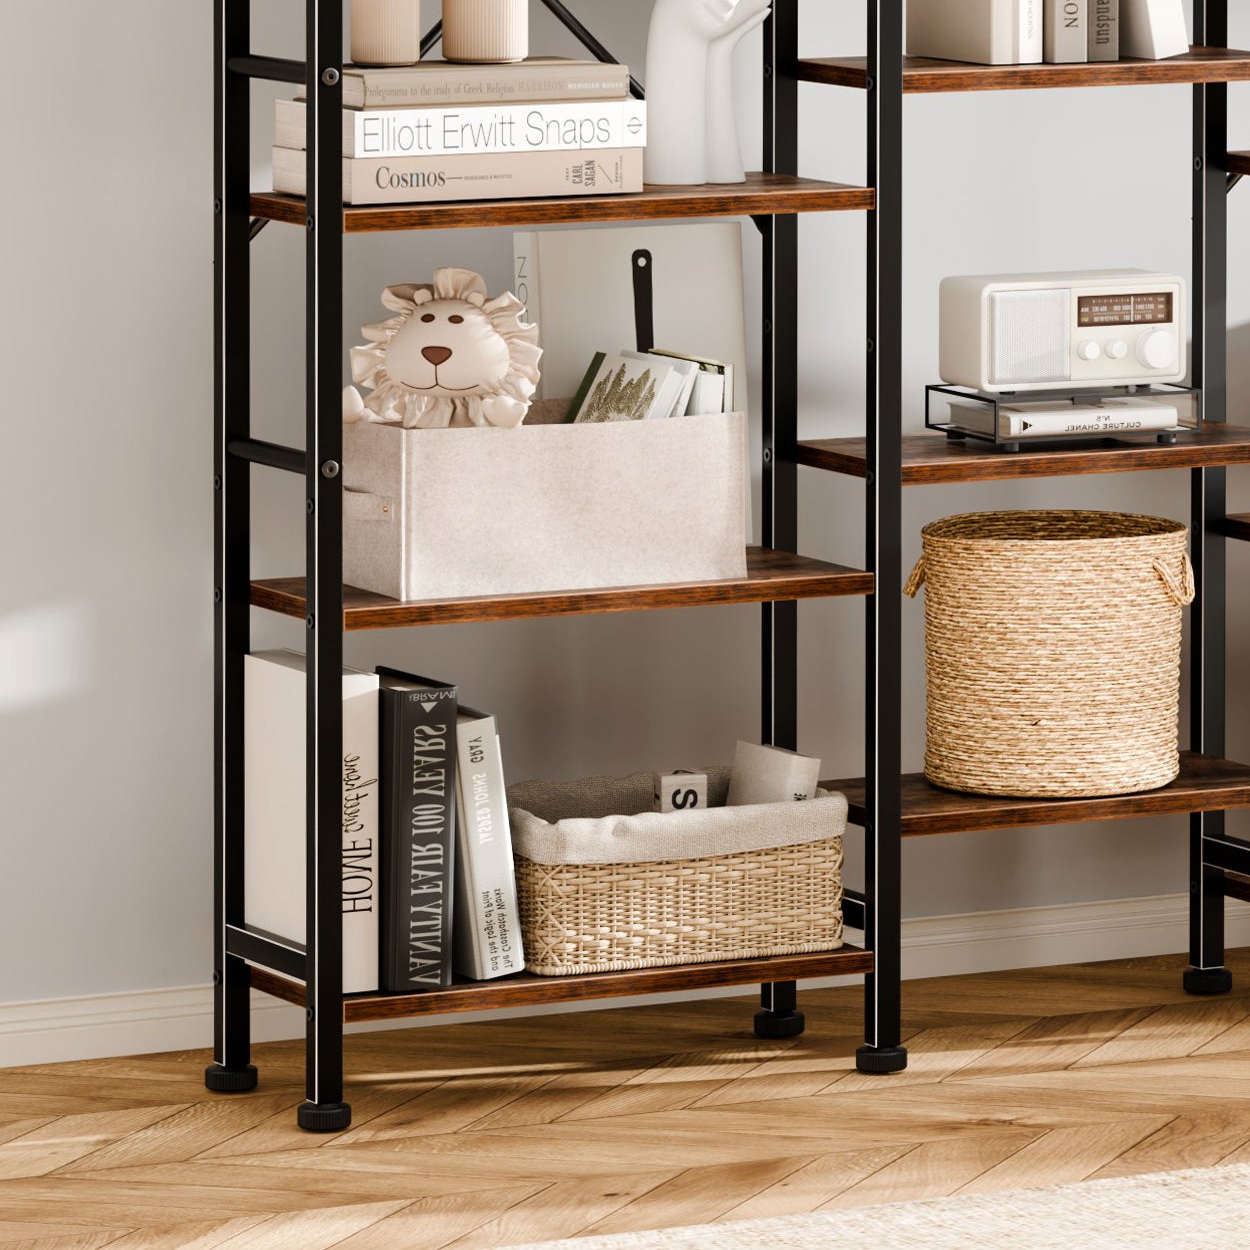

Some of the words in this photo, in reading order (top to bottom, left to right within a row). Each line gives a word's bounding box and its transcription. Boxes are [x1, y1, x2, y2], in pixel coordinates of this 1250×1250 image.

[363, 117, 432, 152] Elliott
[443, 113, 515, 149] Erwitt
[526, 111, 610, 150] Snaps
[376, 166, 446, 190] Cosmos
[573, 165, 583, 185] CARL
[585, 160, 595, 187] SAGAN
